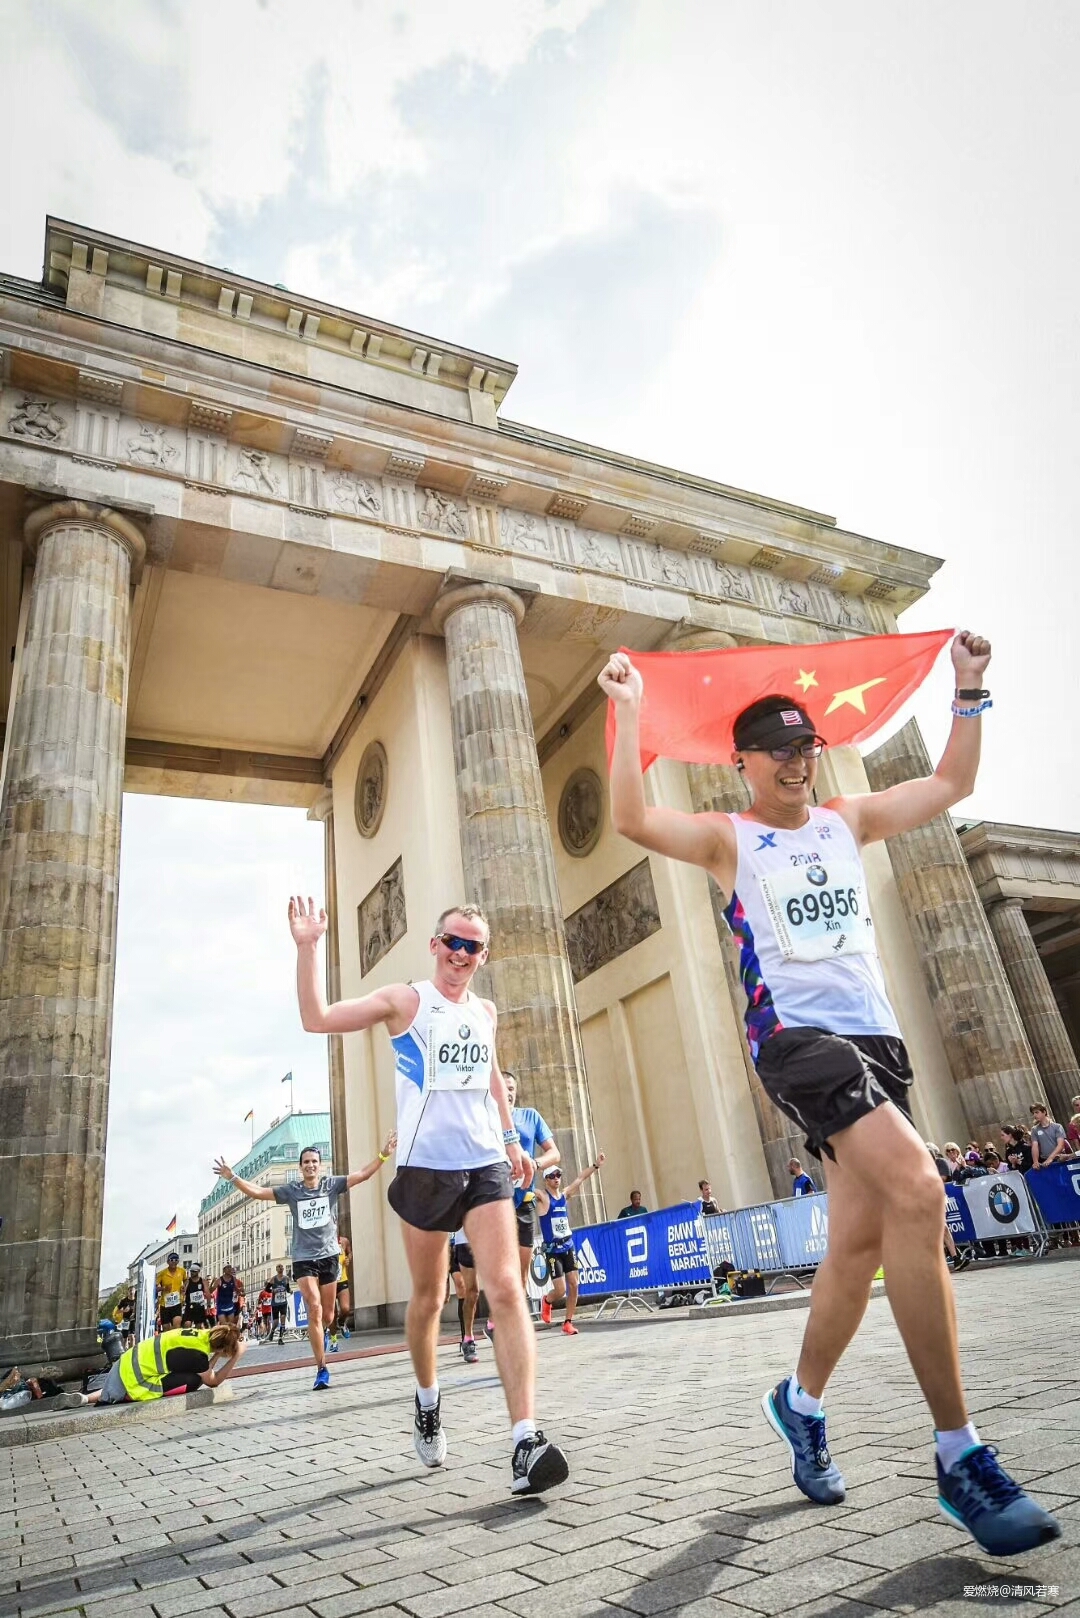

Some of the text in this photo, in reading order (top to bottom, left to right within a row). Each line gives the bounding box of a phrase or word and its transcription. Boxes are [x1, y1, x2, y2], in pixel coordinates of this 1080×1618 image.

[786, 888, 859, 926] 69956
[824, 919, 841, 931] Xin
[438, 1043, 489, 1064] 62103
[455, 1064, 474, 1072] Viktor
[989, 1184, 1014, 1199] BMW
[303, 1206, 325, 1218] 68717
[667, 1220, 694, 1243] BMW
[668, 1239, 698, 1257] BERLIN
[577, 1266, 607, 1285] didas
[629, 1266, 649, 1278] Abbott
